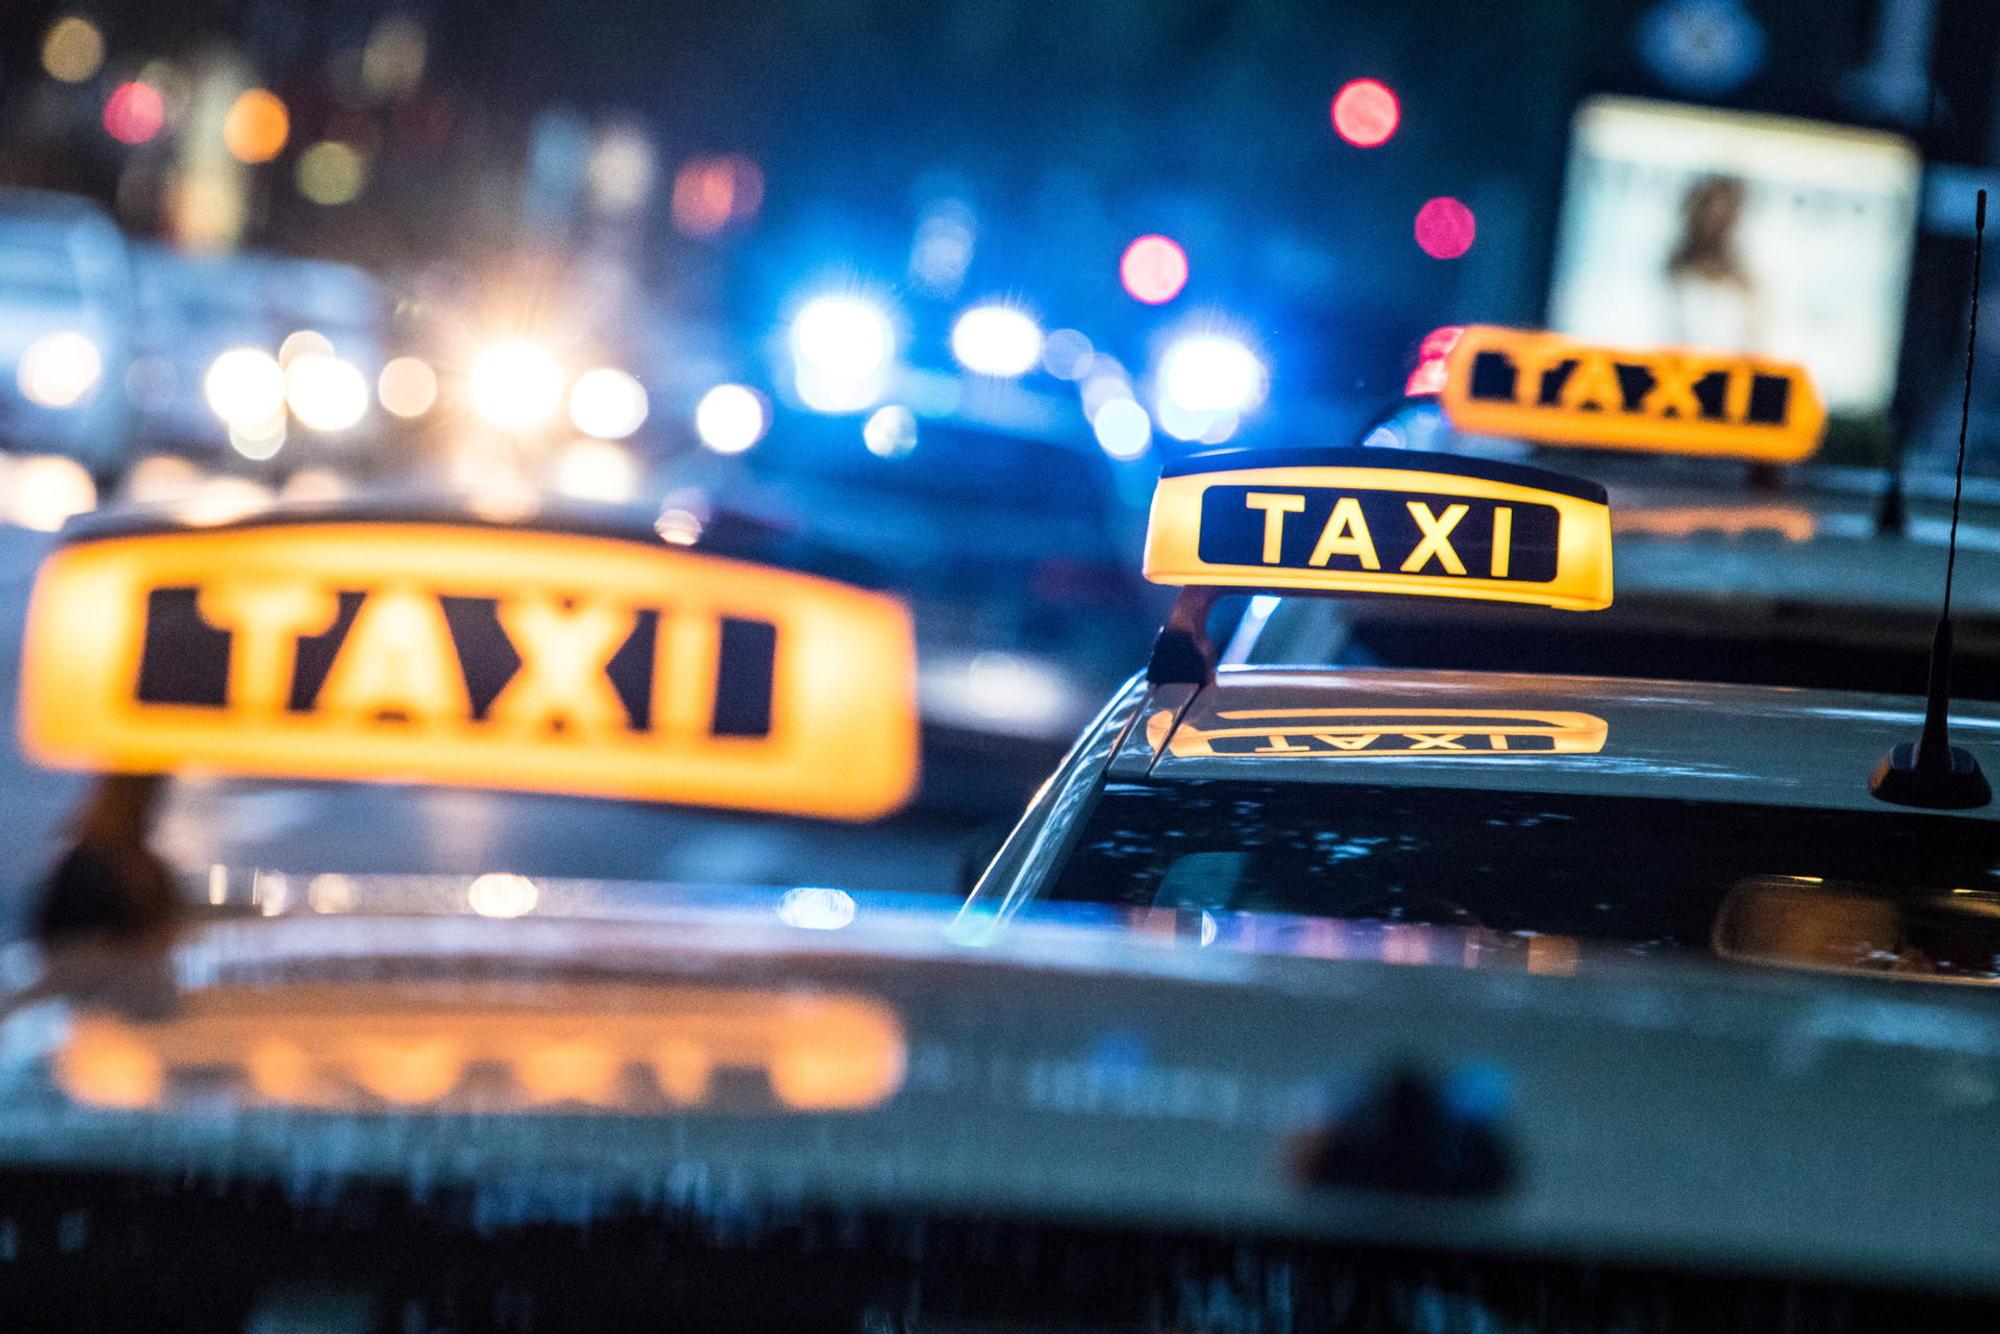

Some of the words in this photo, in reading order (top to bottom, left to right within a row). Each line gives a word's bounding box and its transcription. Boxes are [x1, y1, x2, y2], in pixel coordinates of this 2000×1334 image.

[1503, 350, 1752, 422] TAXI
[1245, 491, 1513, 578] TAXI
[198, 584, 722, 732] TAXI
